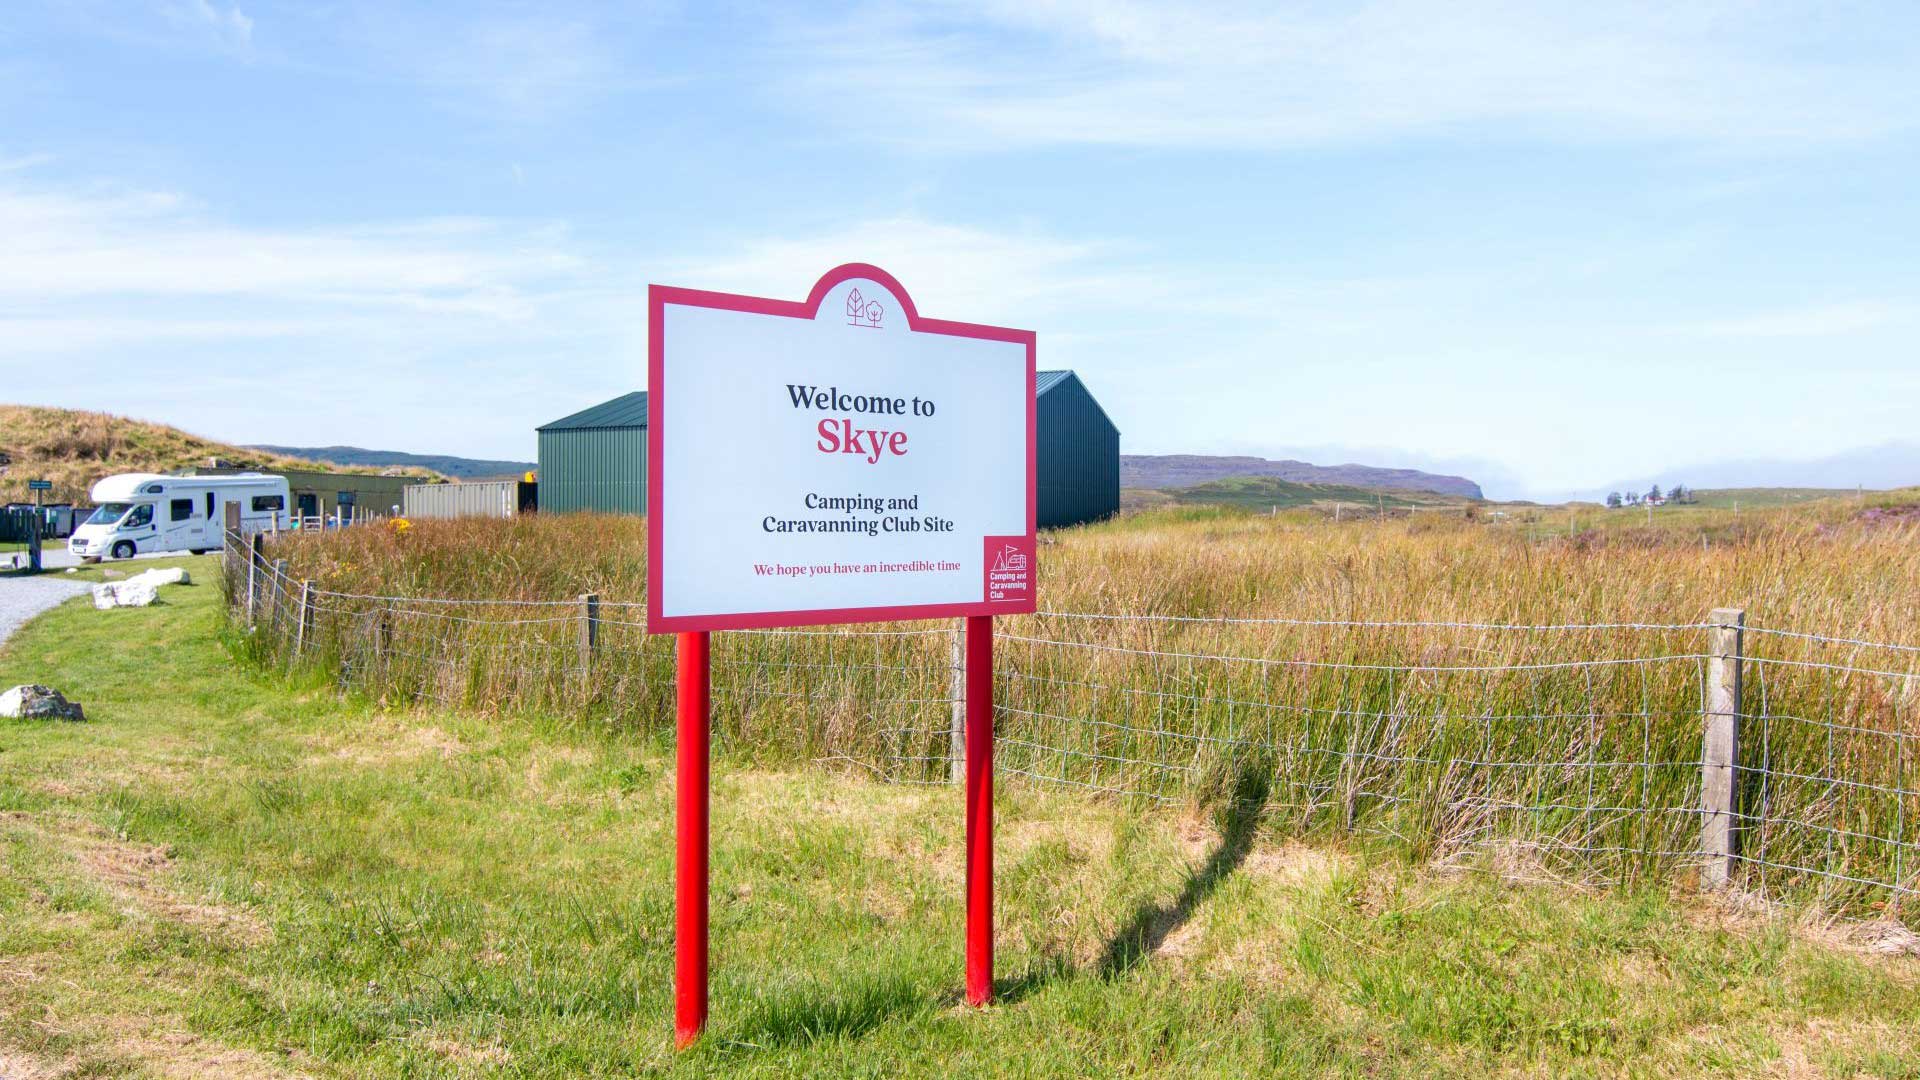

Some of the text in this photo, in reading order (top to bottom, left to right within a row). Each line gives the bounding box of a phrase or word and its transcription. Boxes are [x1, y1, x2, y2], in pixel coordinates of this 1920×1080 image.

[786, 384, 936, 417] Welcome to
[817, 418, 908, 465] Skye
[804, 492, 919, 514] Camping and
[762, 515, 954, 537] Caravanning Club Site
[753, 559, 961, 578] We hope you have an incredible time
[990, 572, 1015, 581] Camping
[990, 581, 1026, 590] Caravanning
[990, 590, 1004, 598] Club
